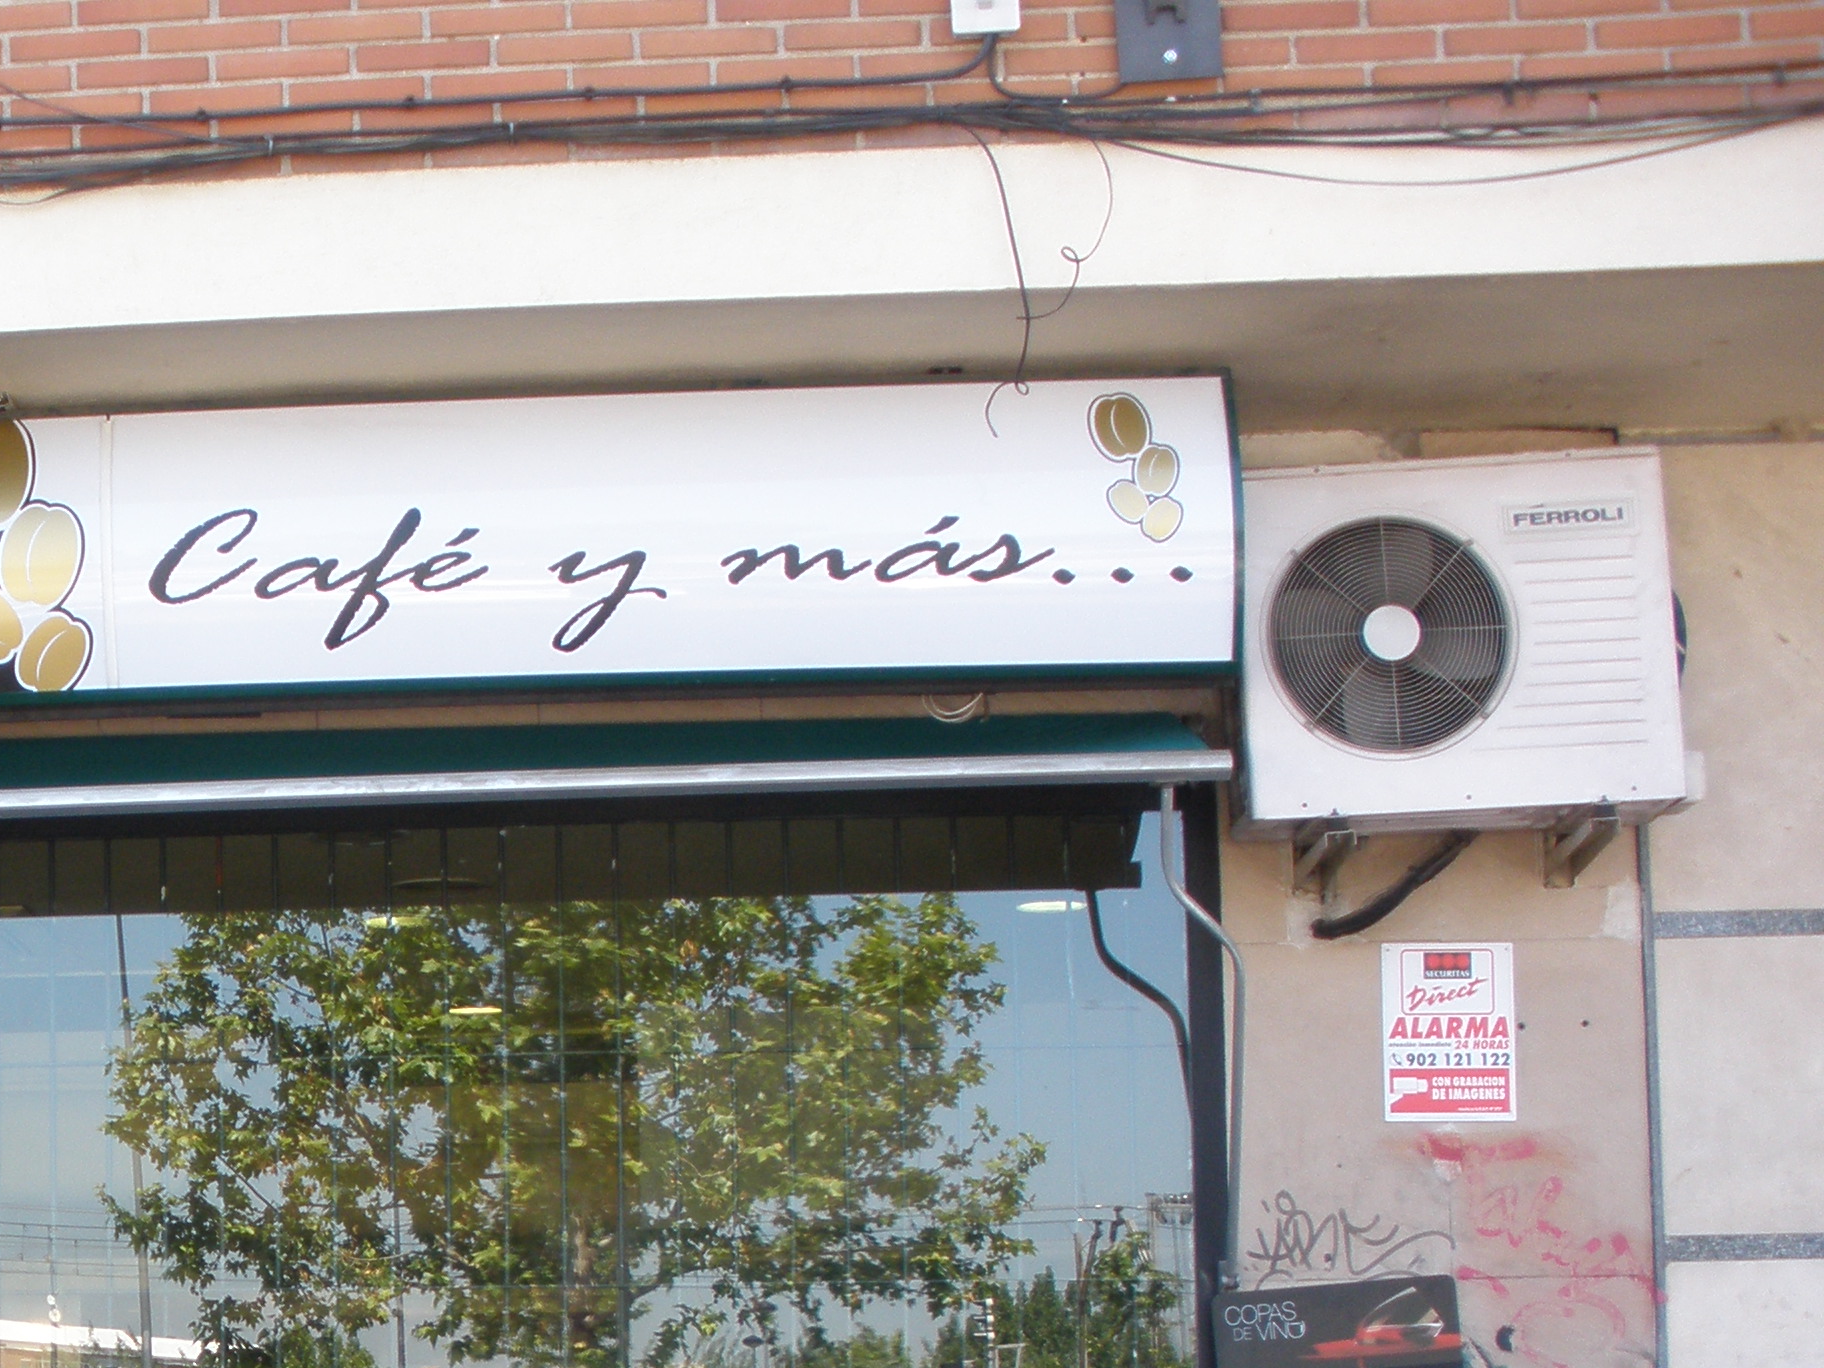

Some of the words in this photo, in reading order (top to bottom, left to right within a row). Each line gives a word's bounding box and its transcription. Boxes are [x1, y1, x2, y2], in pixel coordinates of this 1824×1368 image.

[1513, 506, 1624, 527] FERROLI
[148, 507, 490, 651] Café
[549, 550, 667, 653] y
[721, 516, 1193, 585] más...
[1406, 977, 1489, 1011] Direct
[1388, 1016, 1510, 1040] ALARMA
[1455, 1040, 1469, 1050] 24
[1473, 1039, 1510, 1050] HORAS
[1406, 1053, 1437, 1067] 902
[1444, 1053, 1472, 1066] 121
[1481, 1052, 1511, 1066] 122
[1432, 1076, 1451, 1088] CON
[1453, 1076, 1505, 1088] GRABACION
[1432, 1088, 1446, 1100] DE
[1448, 1088, 1506, 1100] IMAGENES
[1224, 1301, 1297, 1326] COPAS
[1233, 1327, 1253, 1341] DE
[1255, 1320, 1306, 1341] VINO
